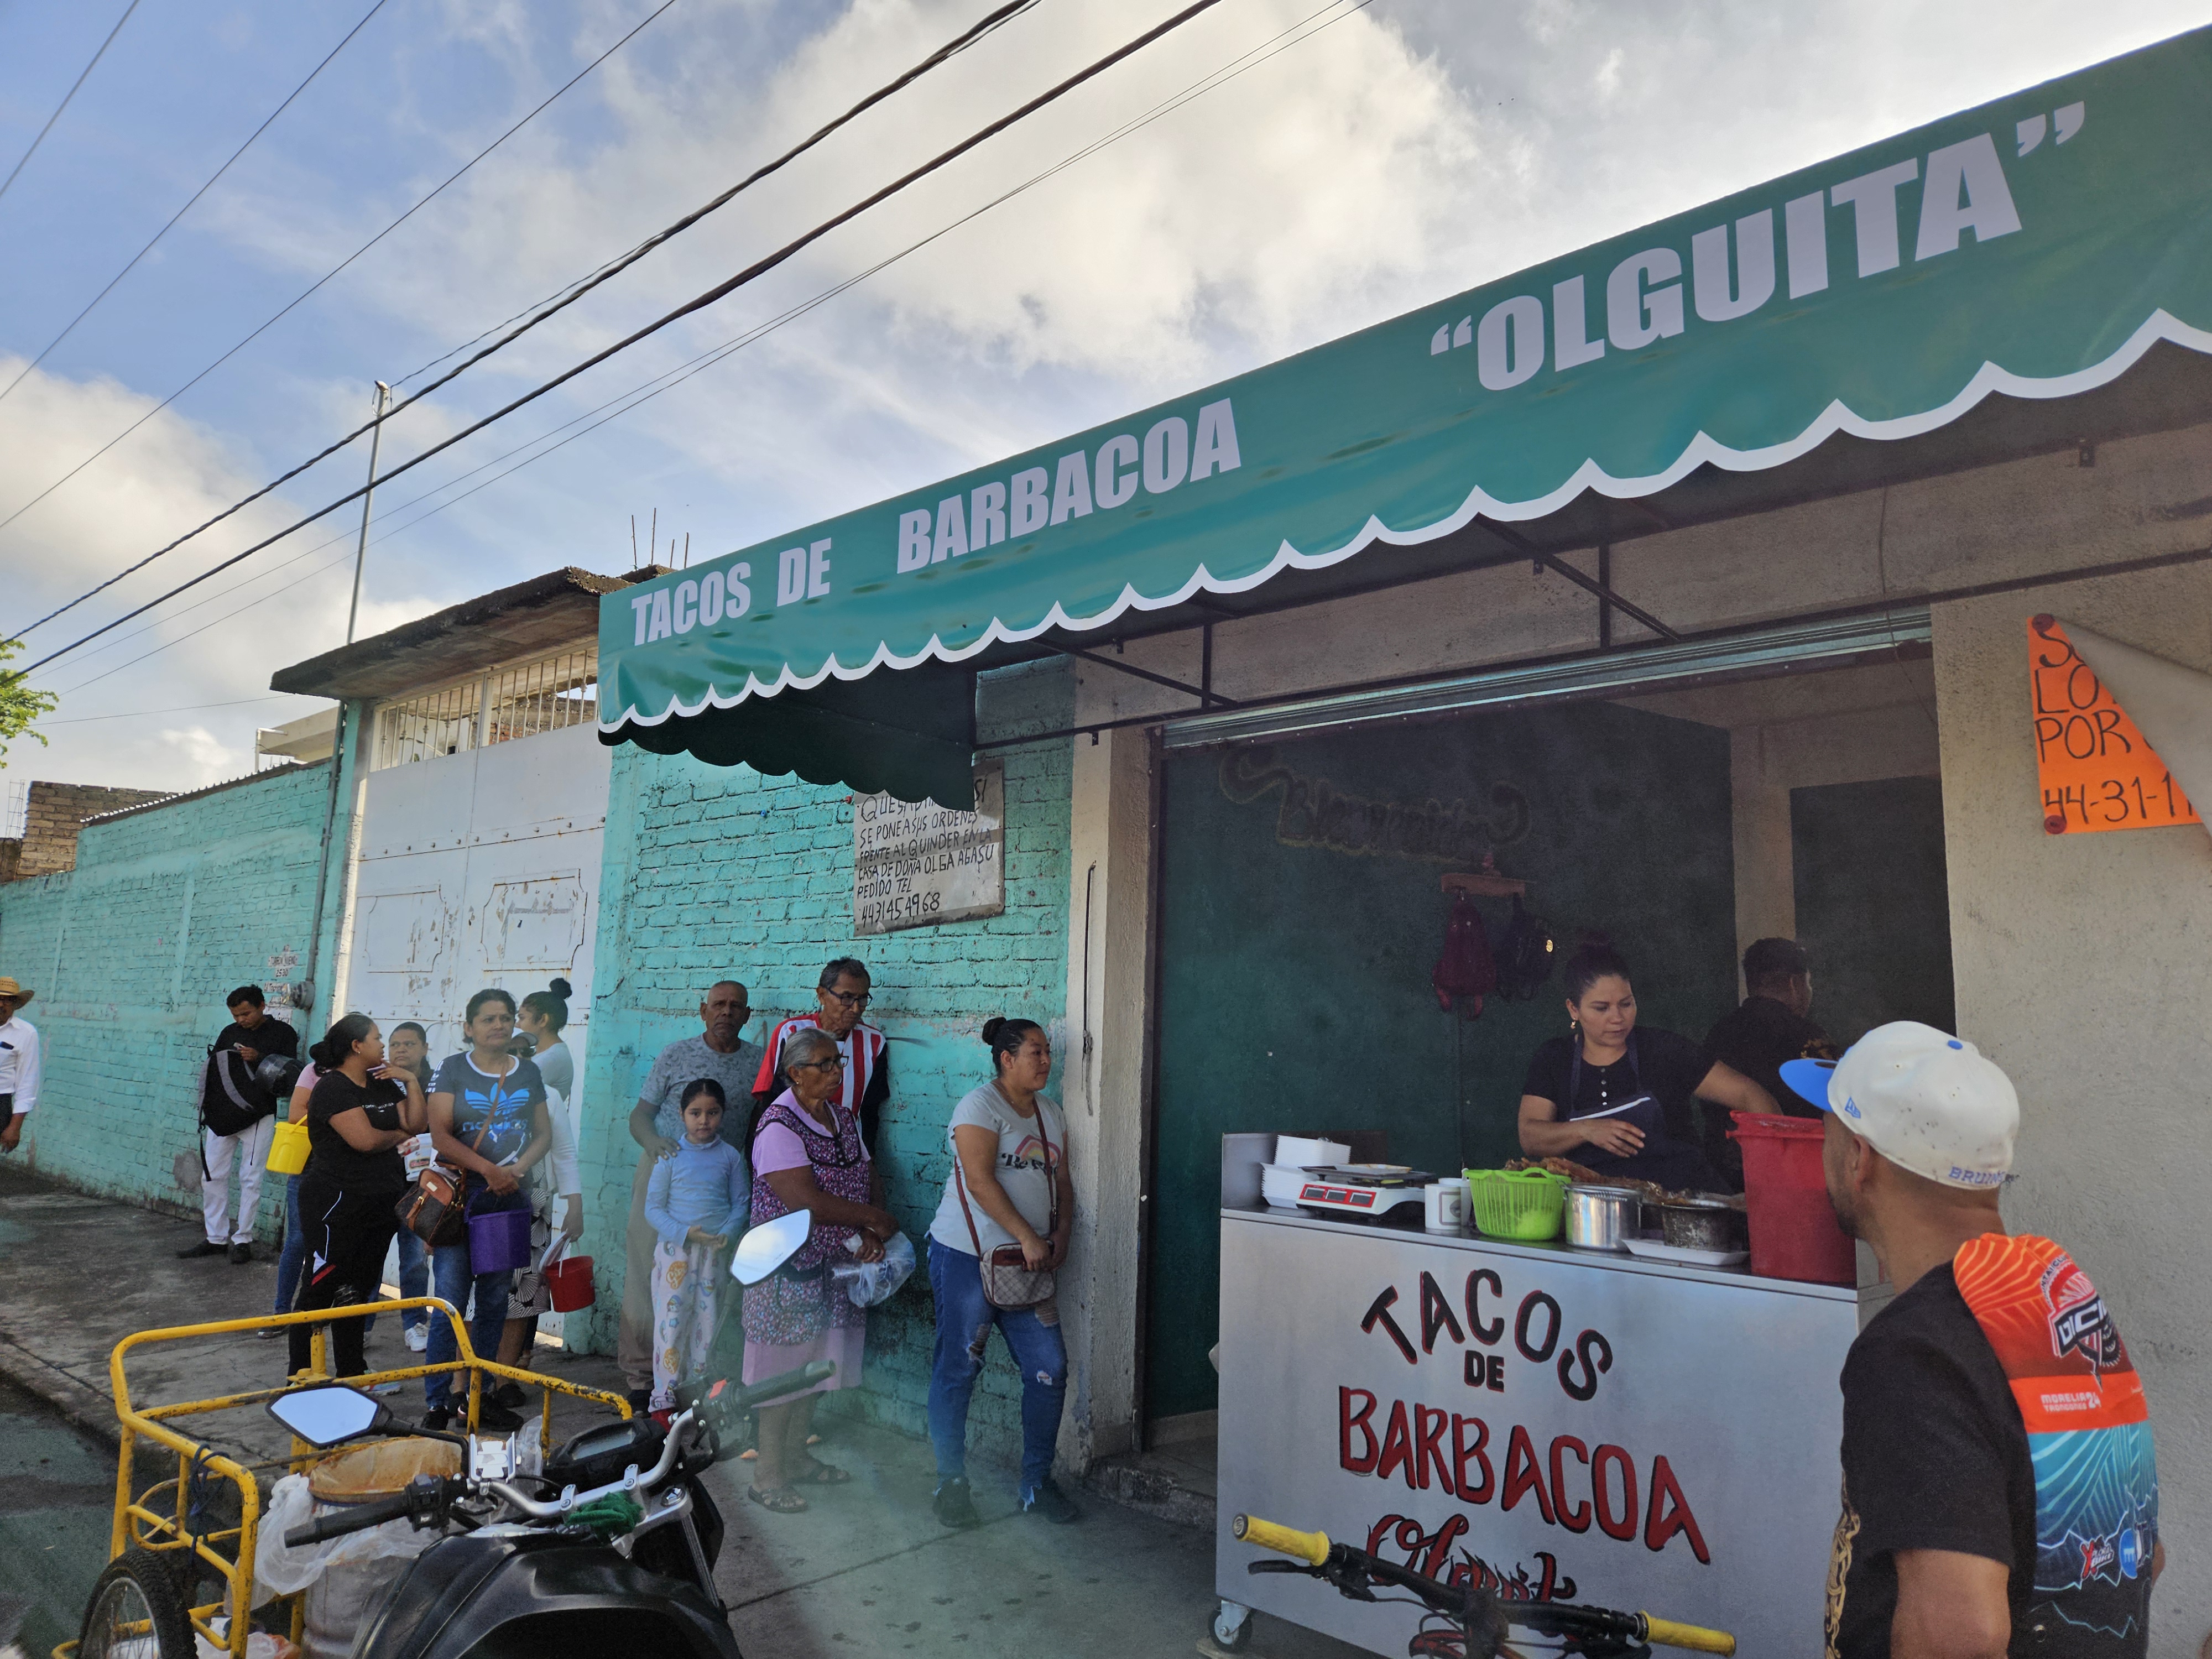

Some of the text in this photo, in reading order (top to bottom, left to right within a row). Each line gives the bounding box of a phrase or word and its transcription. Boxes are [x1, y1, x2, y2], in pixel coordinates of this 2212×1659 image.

[631, 561, 751, 646] TACOS
[776, 537, 832, 607] DE
[896, 397, 1242, 574] BARBACOA
[2034, 709, 2131, 763] POR
[860, 828, 873, 849] SE
[931, 806, 980, 828] ORDENES
[858, 864, 879, 880] CASA
[881, 861, 894, 878] DE
[895, 858, 921, 878] DOÑA
[924, 852, 955, 874] OLGA
[860, 847, 891, 868] FRENTE
[893, 842, 906, 858] AL
[908, 831, 960, 858] QUINDER
[857, 877, 912, 899] PEDIDO TEL
[1360, 1268, 1614, 1401] TACOS
[1463, 1350, 1505, 1393] DE
[1338, 1385, 1710, 1566] BARBACOA
